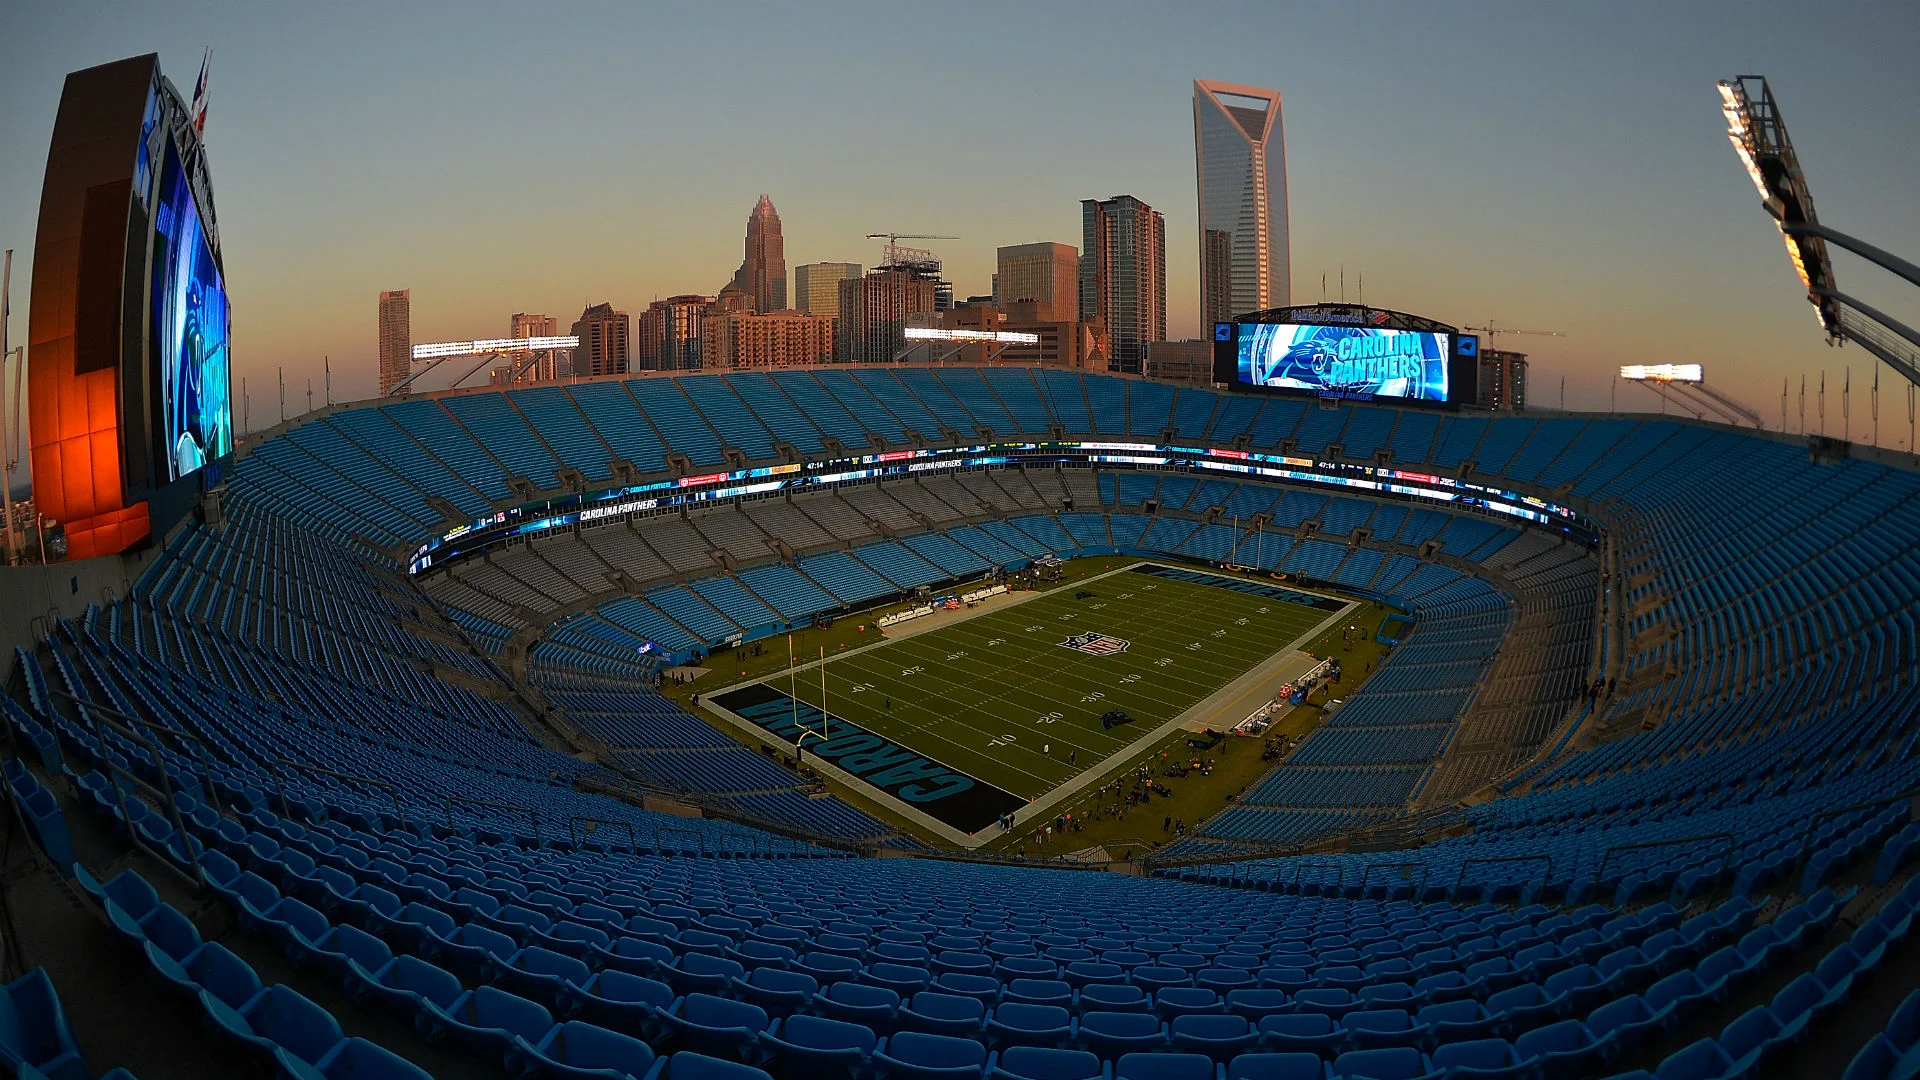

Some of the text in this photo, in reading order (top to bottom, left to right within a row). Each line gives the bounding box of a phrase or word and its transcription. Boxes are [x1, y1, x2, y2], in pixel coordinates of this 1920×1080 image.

[1326, 309, 1364, 323] America
[1338, 333, 1422, 363] CAROLINA
[1329, 354, 1422, 385] PANTHERS
[807, 461, 824, 470] 47:14
[909, 459, 962, 472] CAROLINA PANTHERS
[1319, 462, 1336, 470] 47:14
[580, 499, 658, 521] CAROLINA PANTHERS
[1081, 691, 1106, 704] 30
[1038, 711, 1064, 724] 20
[989, 734, 1017, 747] 10
[736, 697, 975, 803] CAROLINA
